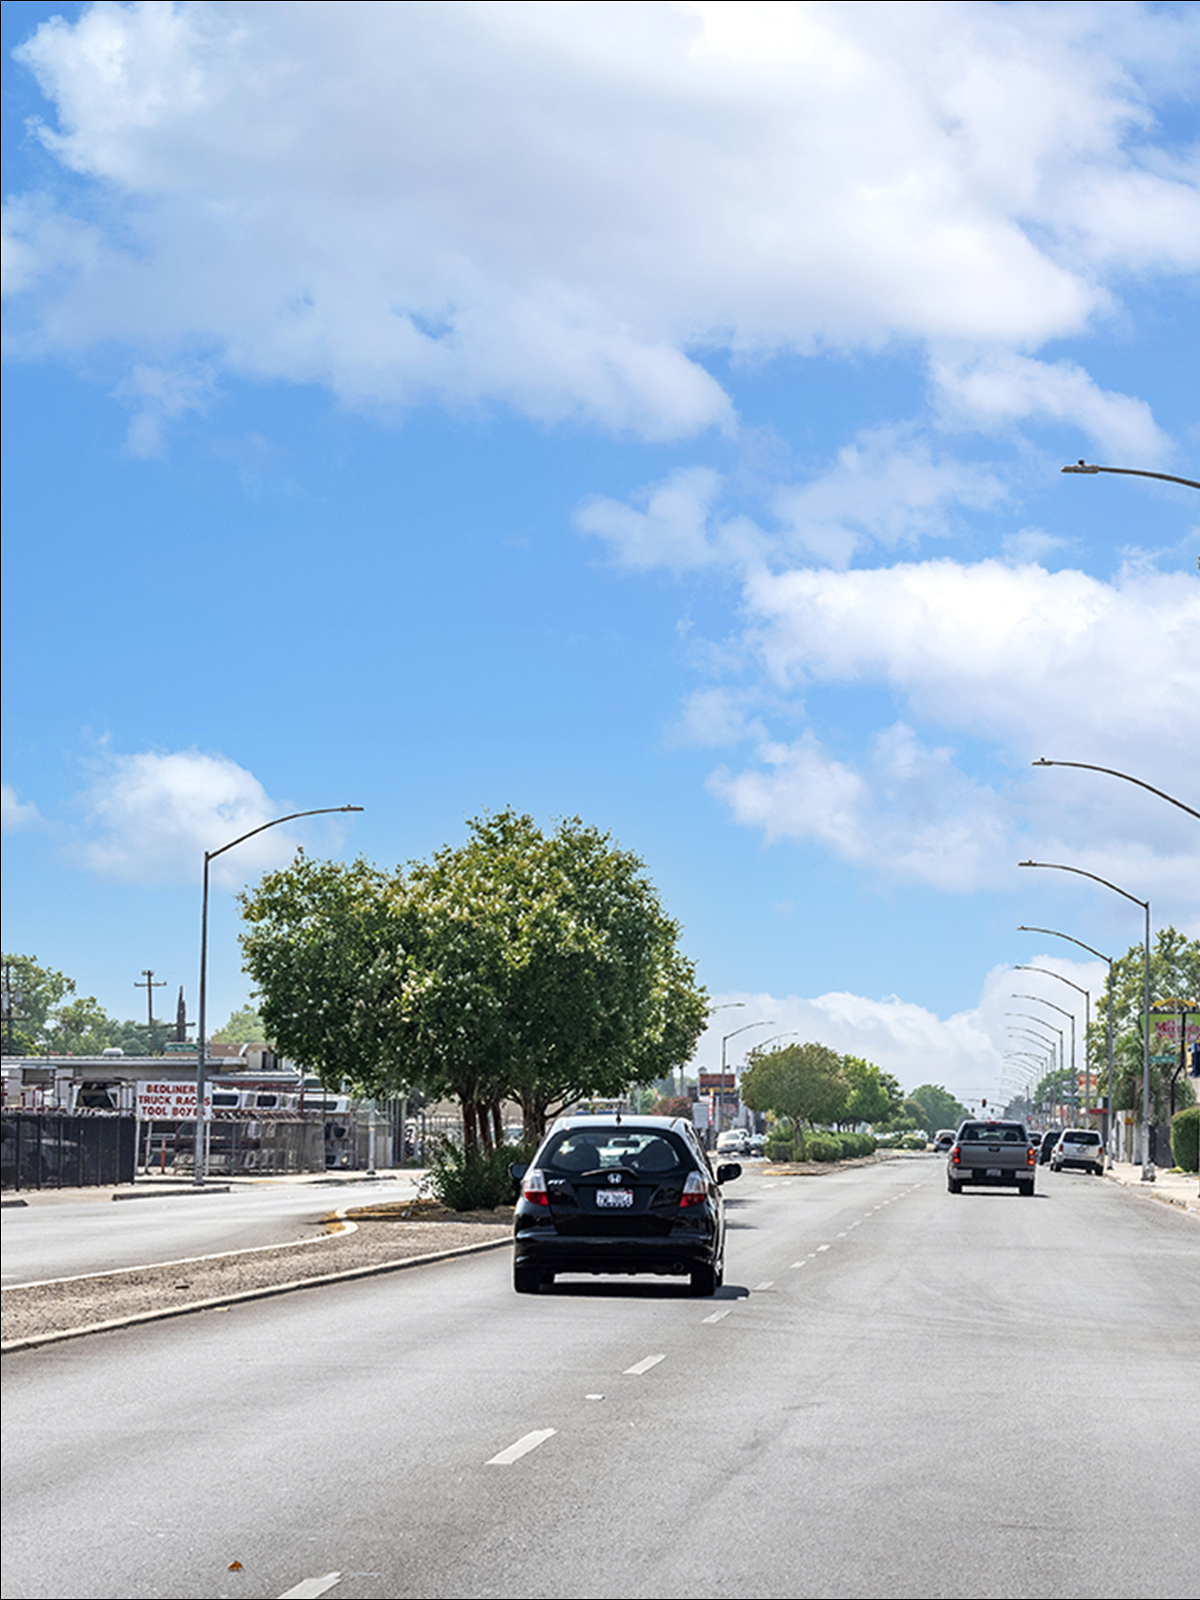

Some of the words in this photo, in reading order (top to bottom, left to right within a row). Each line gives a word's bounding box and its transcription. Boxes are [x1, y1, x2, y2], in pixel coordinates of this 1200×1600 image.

[146, 1084, 198, 1094] BEDLINER
[138, 1095, 172, 1105] TRUCK
[175, 1096, 211, 1106] RACS
[142, 1106, 167, 1116] TOOL
